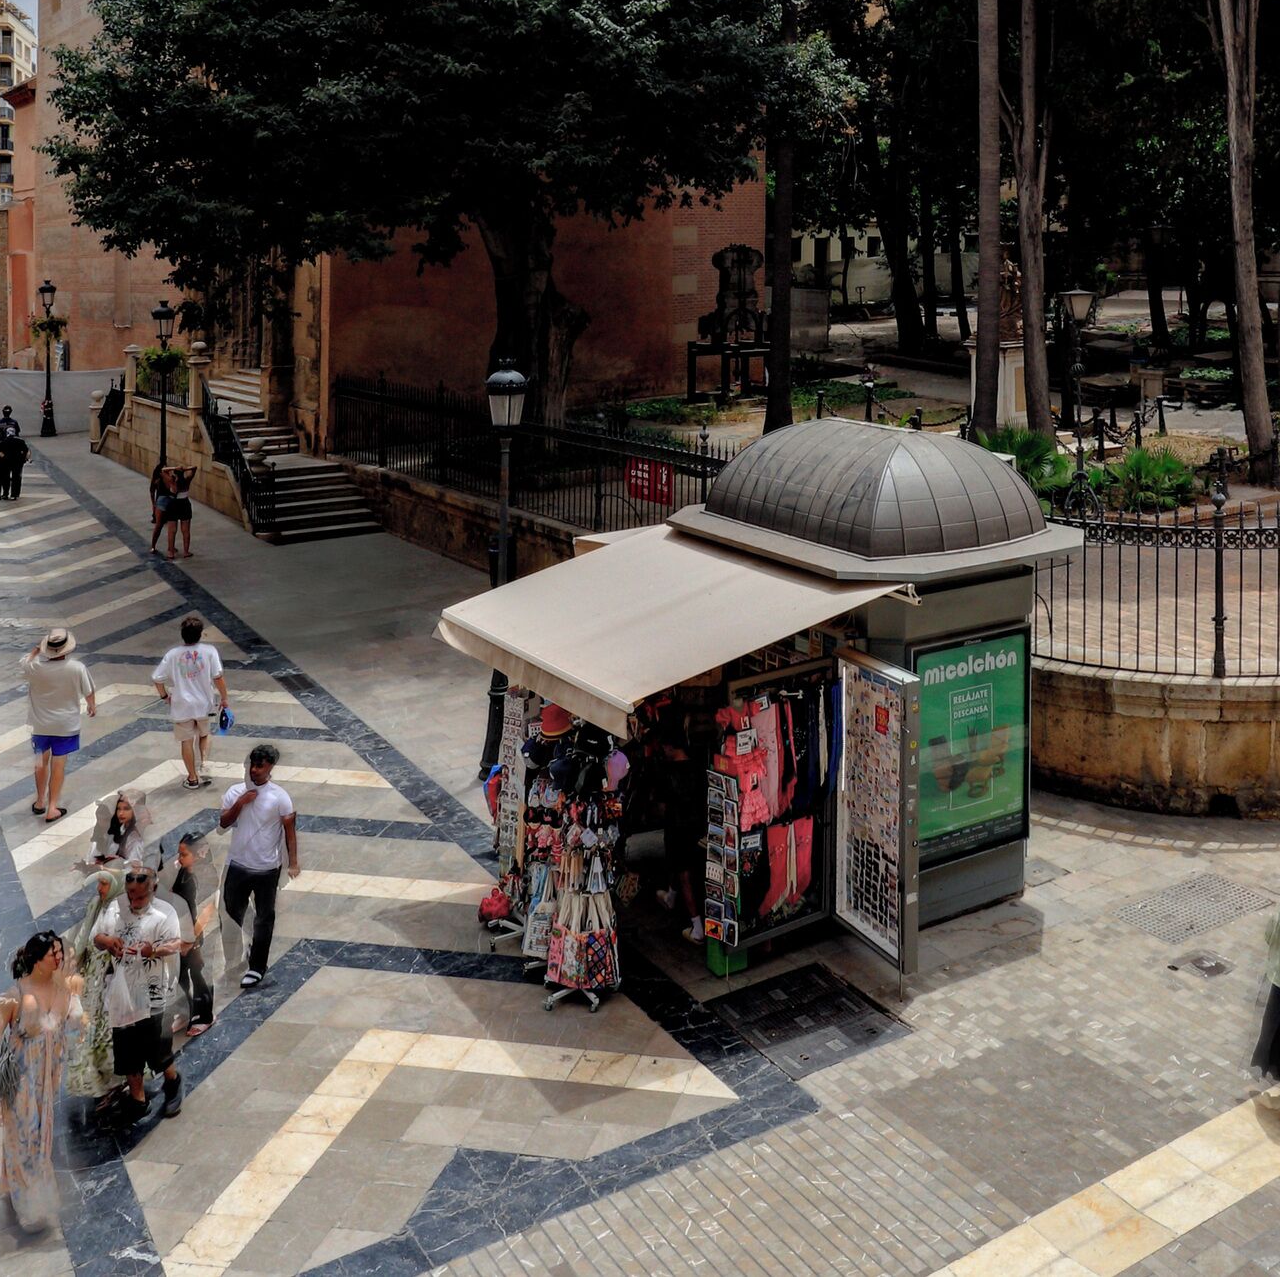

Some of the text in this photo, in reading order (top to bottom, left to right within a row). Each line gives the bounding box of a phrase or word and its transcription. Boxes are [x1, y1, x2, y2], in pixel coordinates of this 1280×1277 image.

[923, 649, 1018, 687] micolchón
[953, 689, 988, 705] RELÁJATE
[953, 704, 988, 720] DESCANSA
